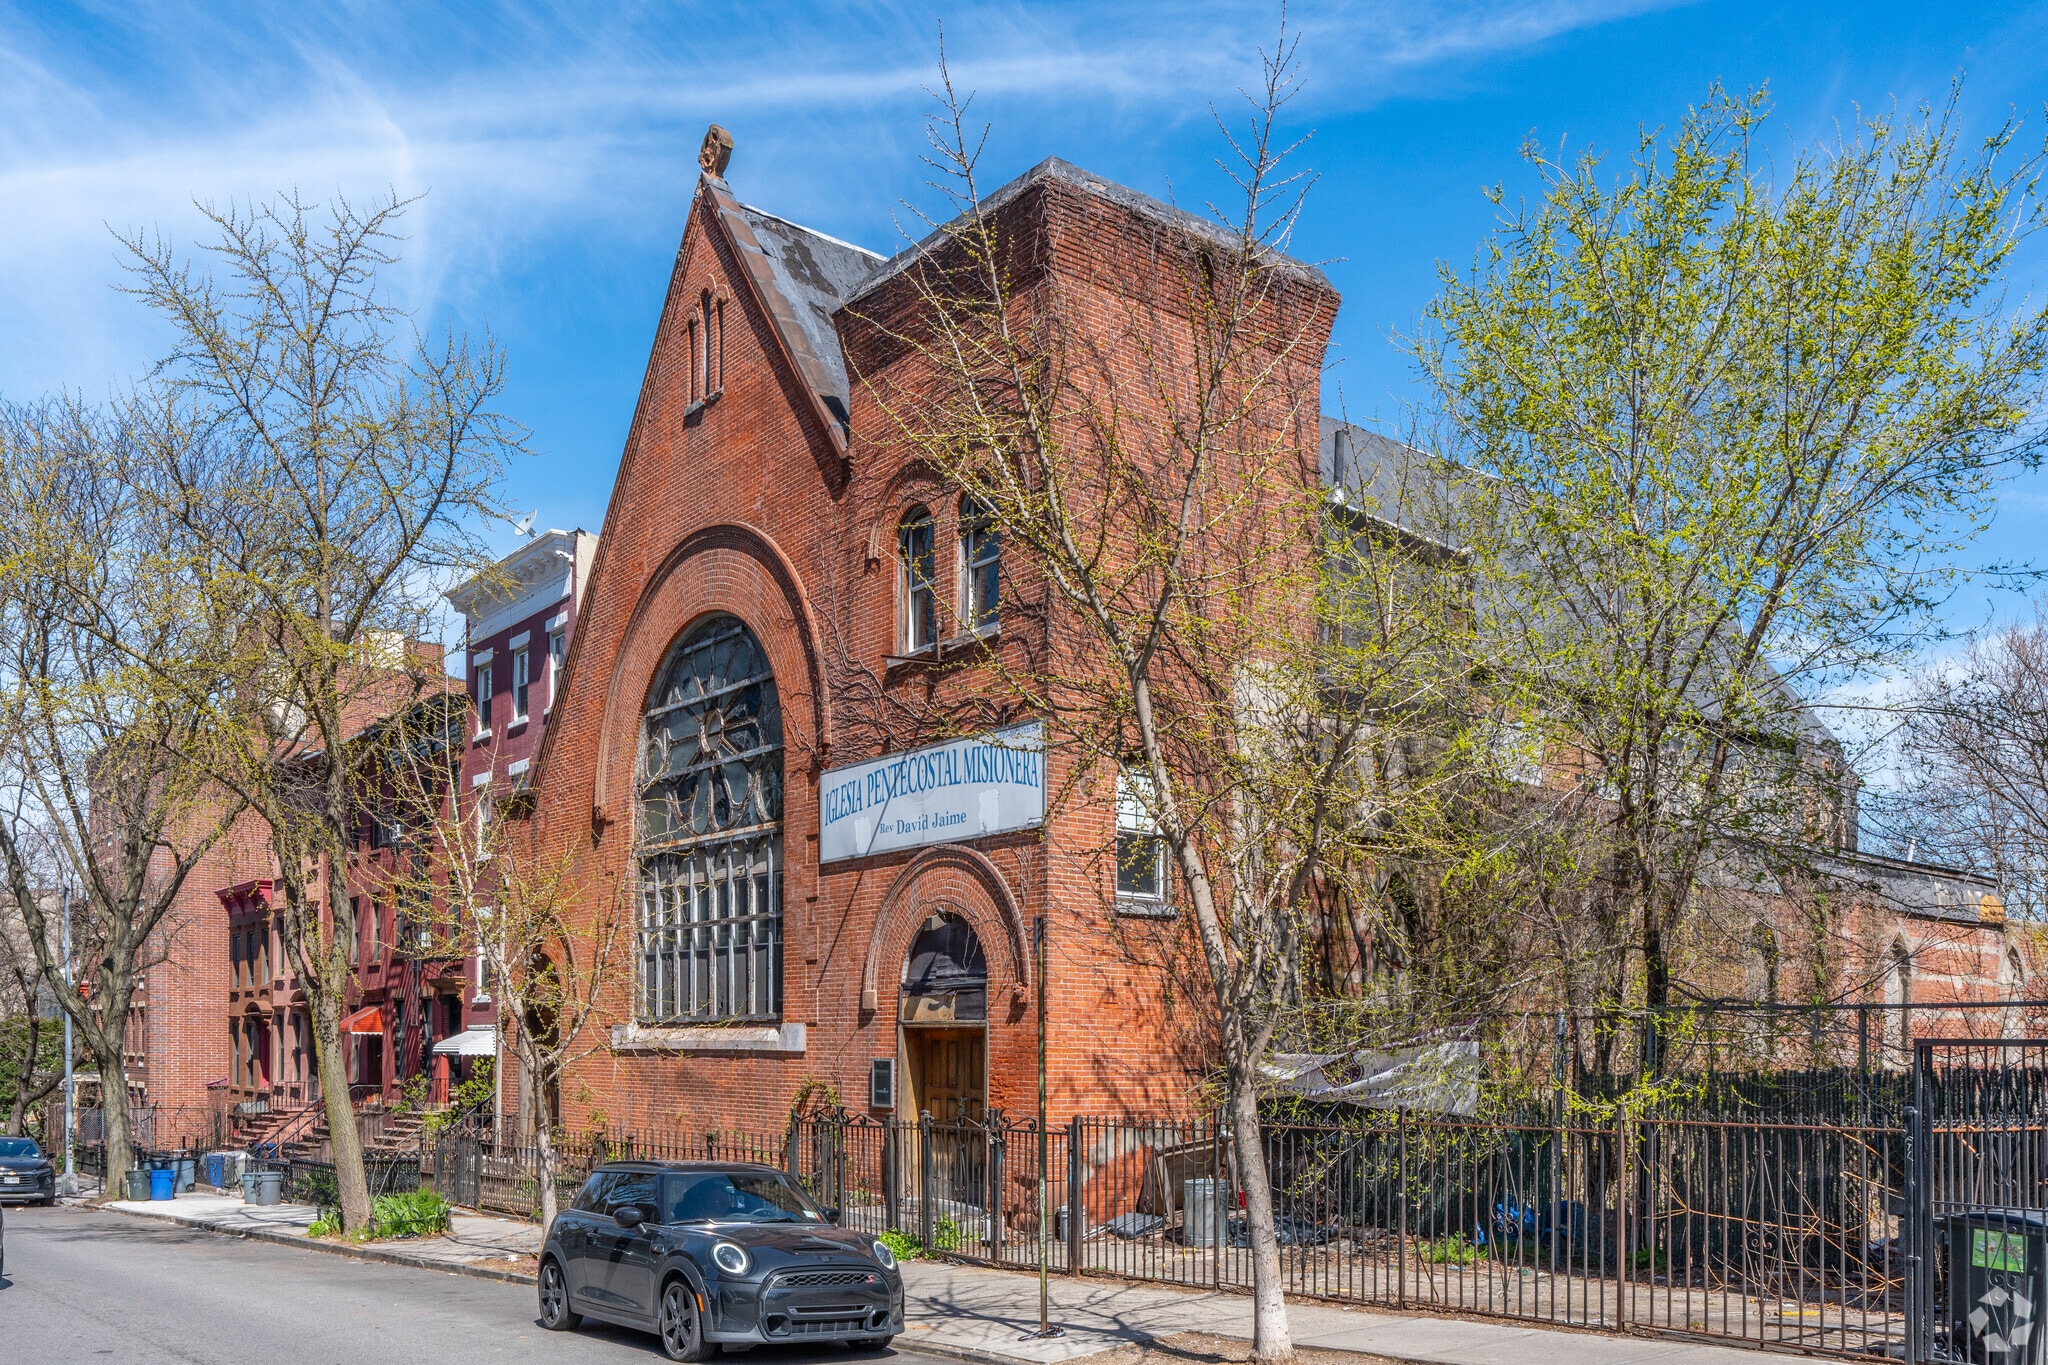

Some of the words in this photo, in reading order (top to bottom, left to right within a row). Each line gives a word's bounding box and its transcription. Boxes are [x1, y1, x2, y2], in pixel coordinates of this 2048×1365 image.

[825, 778, 863, 827] IGLESIA
[867, 748, 961, 808] PENTECOSTAL
[963, 745, 1039, 788] MISIONERA
[880, 823, 894, 834] Rev
[896, 814, 929, 835] David
[932, 811, 967, 829] Jaime
